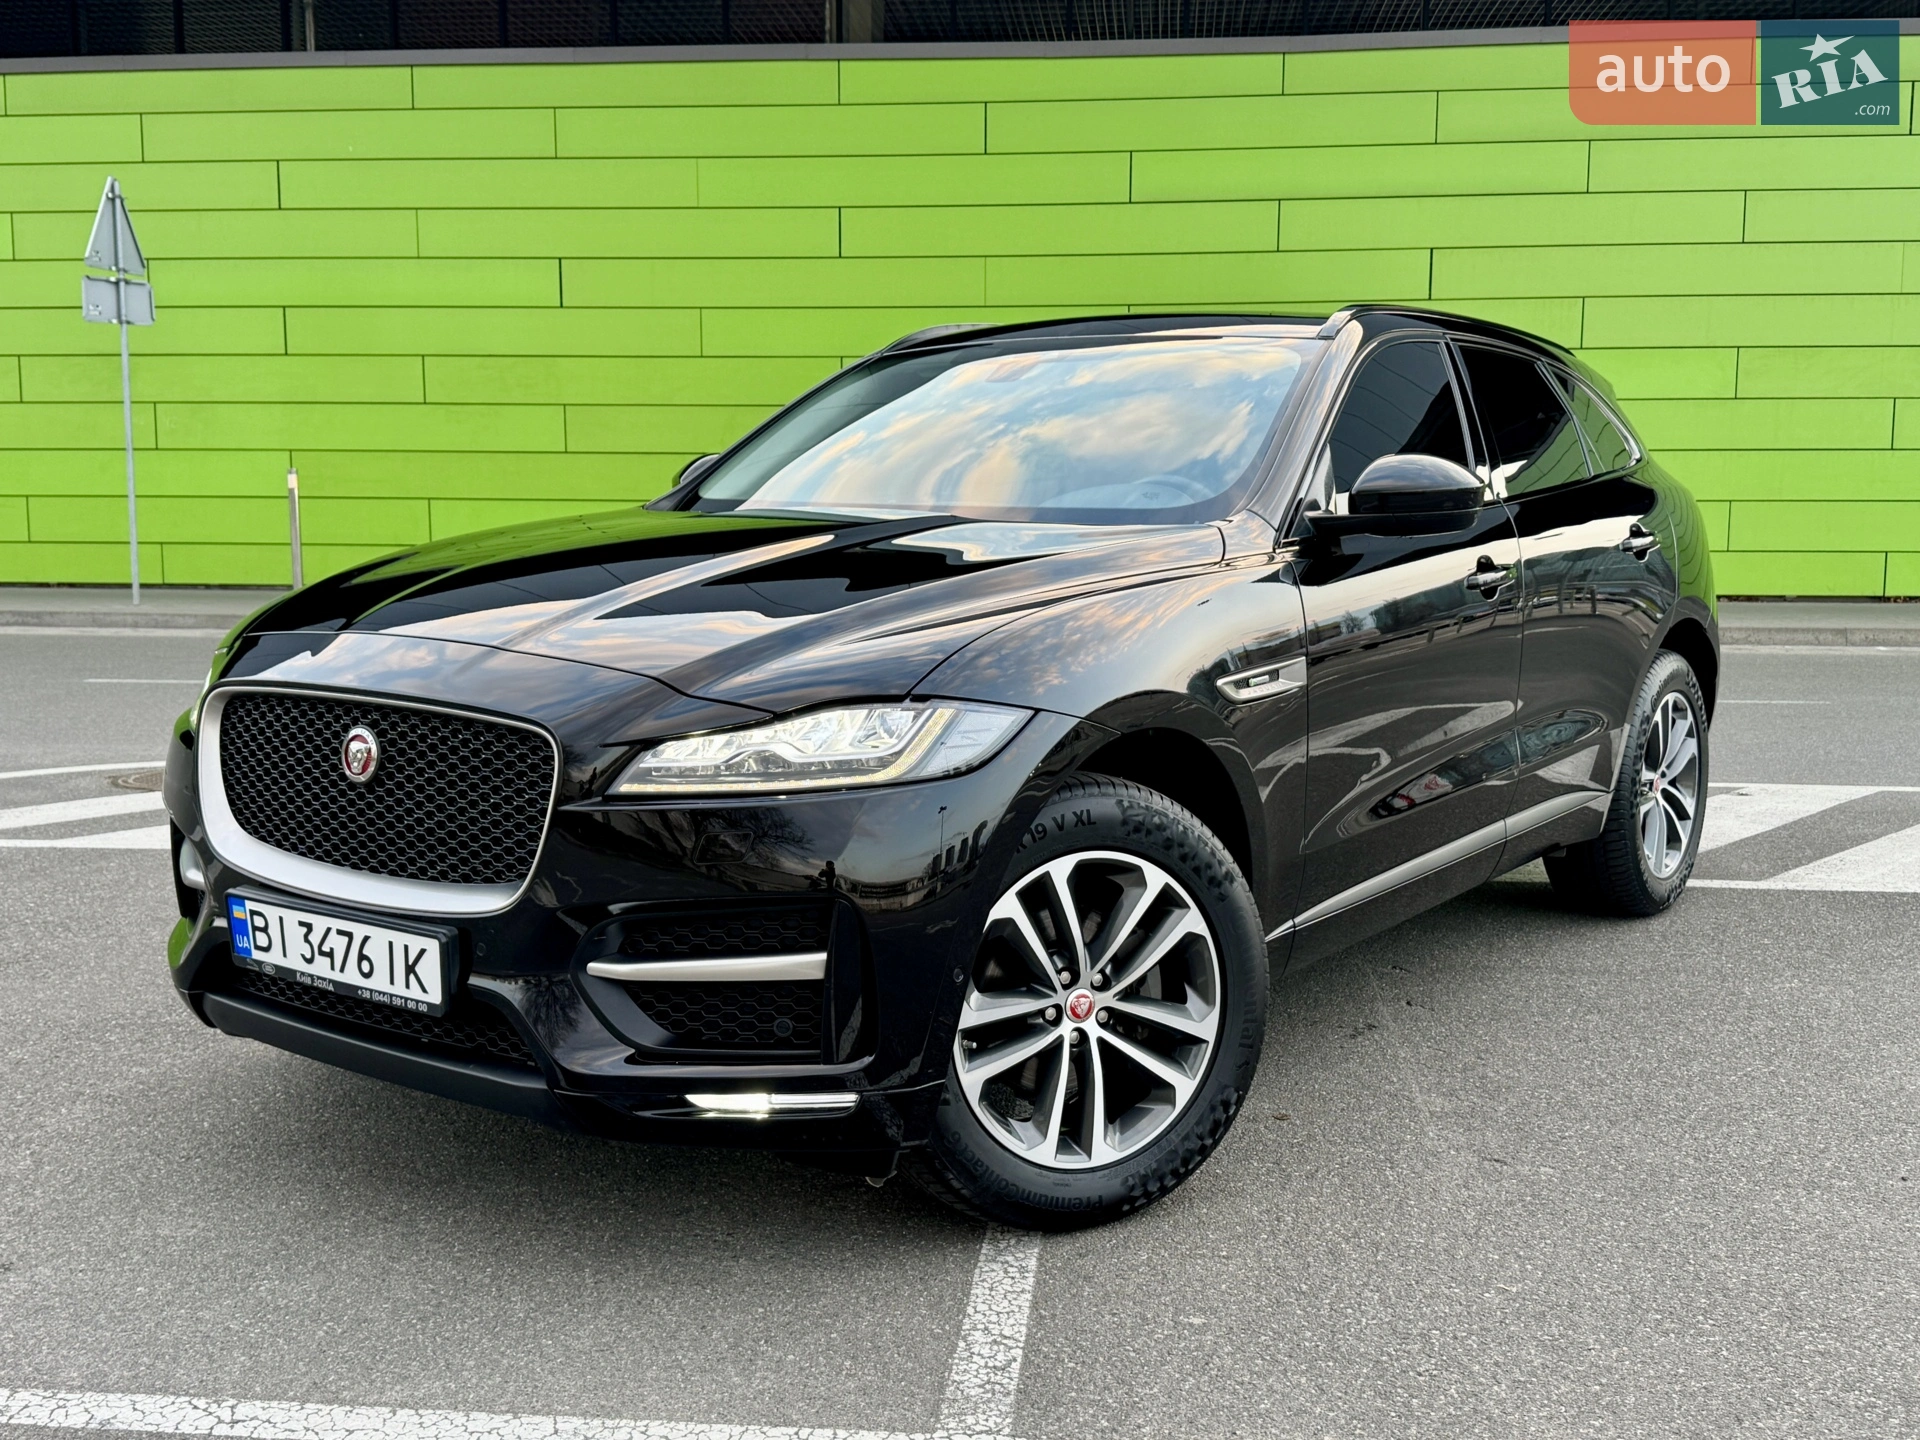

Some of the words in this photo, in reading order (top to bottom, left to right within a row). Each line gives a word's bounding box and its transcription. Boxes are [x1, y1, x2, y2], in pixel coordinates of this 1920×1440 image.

[1026, 822, 1047, 844] 19
[1051, 814, 1065, 832] V
[1072, 808, 1097, 828] XL
[236, 934, 250, 949] UA
[249, 908, 288, 959] BI
[298, 920, 374, 979] 3476
[388, 940, 429, 994] IK
[296, 971, 312, 984] Київ
[357, 989, 371, 998] +38
[372, 990, 390, 1004] (044)
[392, 996, 405, 1007] 591
[407, 1000, 416, 1009] 00
[418, 1002, 428, 1012] 00
